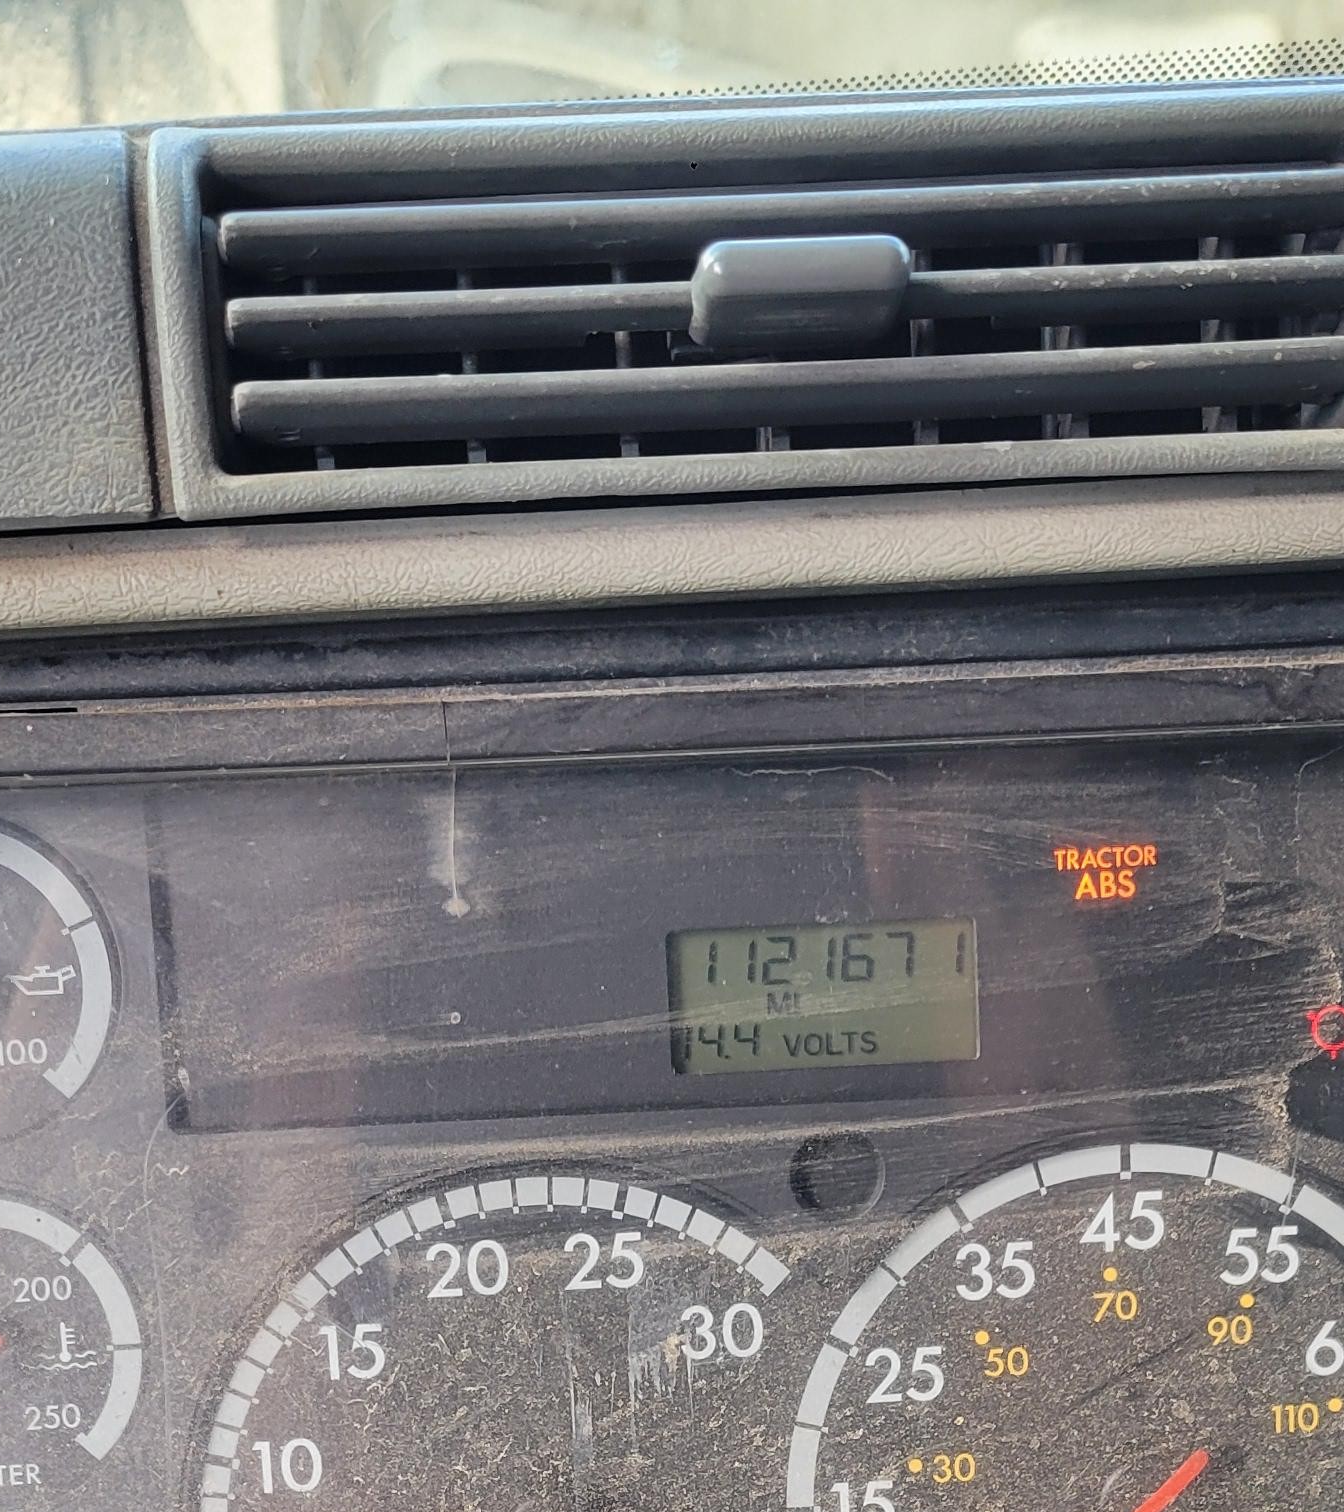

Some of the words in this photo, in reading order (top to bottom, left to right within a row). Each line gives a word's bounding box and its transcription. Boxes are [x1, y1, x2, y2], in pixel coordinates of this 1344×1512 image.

[1053, 844, 1157, 872] TRACTOR
[1075, 869, 1136, 900] ABS
[766, 992, 802, 1015] MI
[782, 1030, 880, 1058] VOLTS
[1079, 1190, 1166, 1253] 45
[425, 1239, 510, 1299] 20
[564, 1231, 645, 1292] 25
[955, 1240, 1036, 1301] 35
[1218, 1225, 1301, 1287] 55
[13, 1275, 73, 1303] 200
[1093, 1289, 1139, 1323] 70
[680, 1303, 765, 1360] 30
[1206, 1314, 1253, 1346] 90
[319, 1323, 386, 1382] 15
[983, 1345, 1029, 1378] 50
[863, 1344, 946, 1404] 25
[24, 1402, 82, 1431] 250
[1271, 1401, 1320, 1435] 110
[252, 1437, 323, 1495] 10
[931, 1452, 977, 1484] 30
